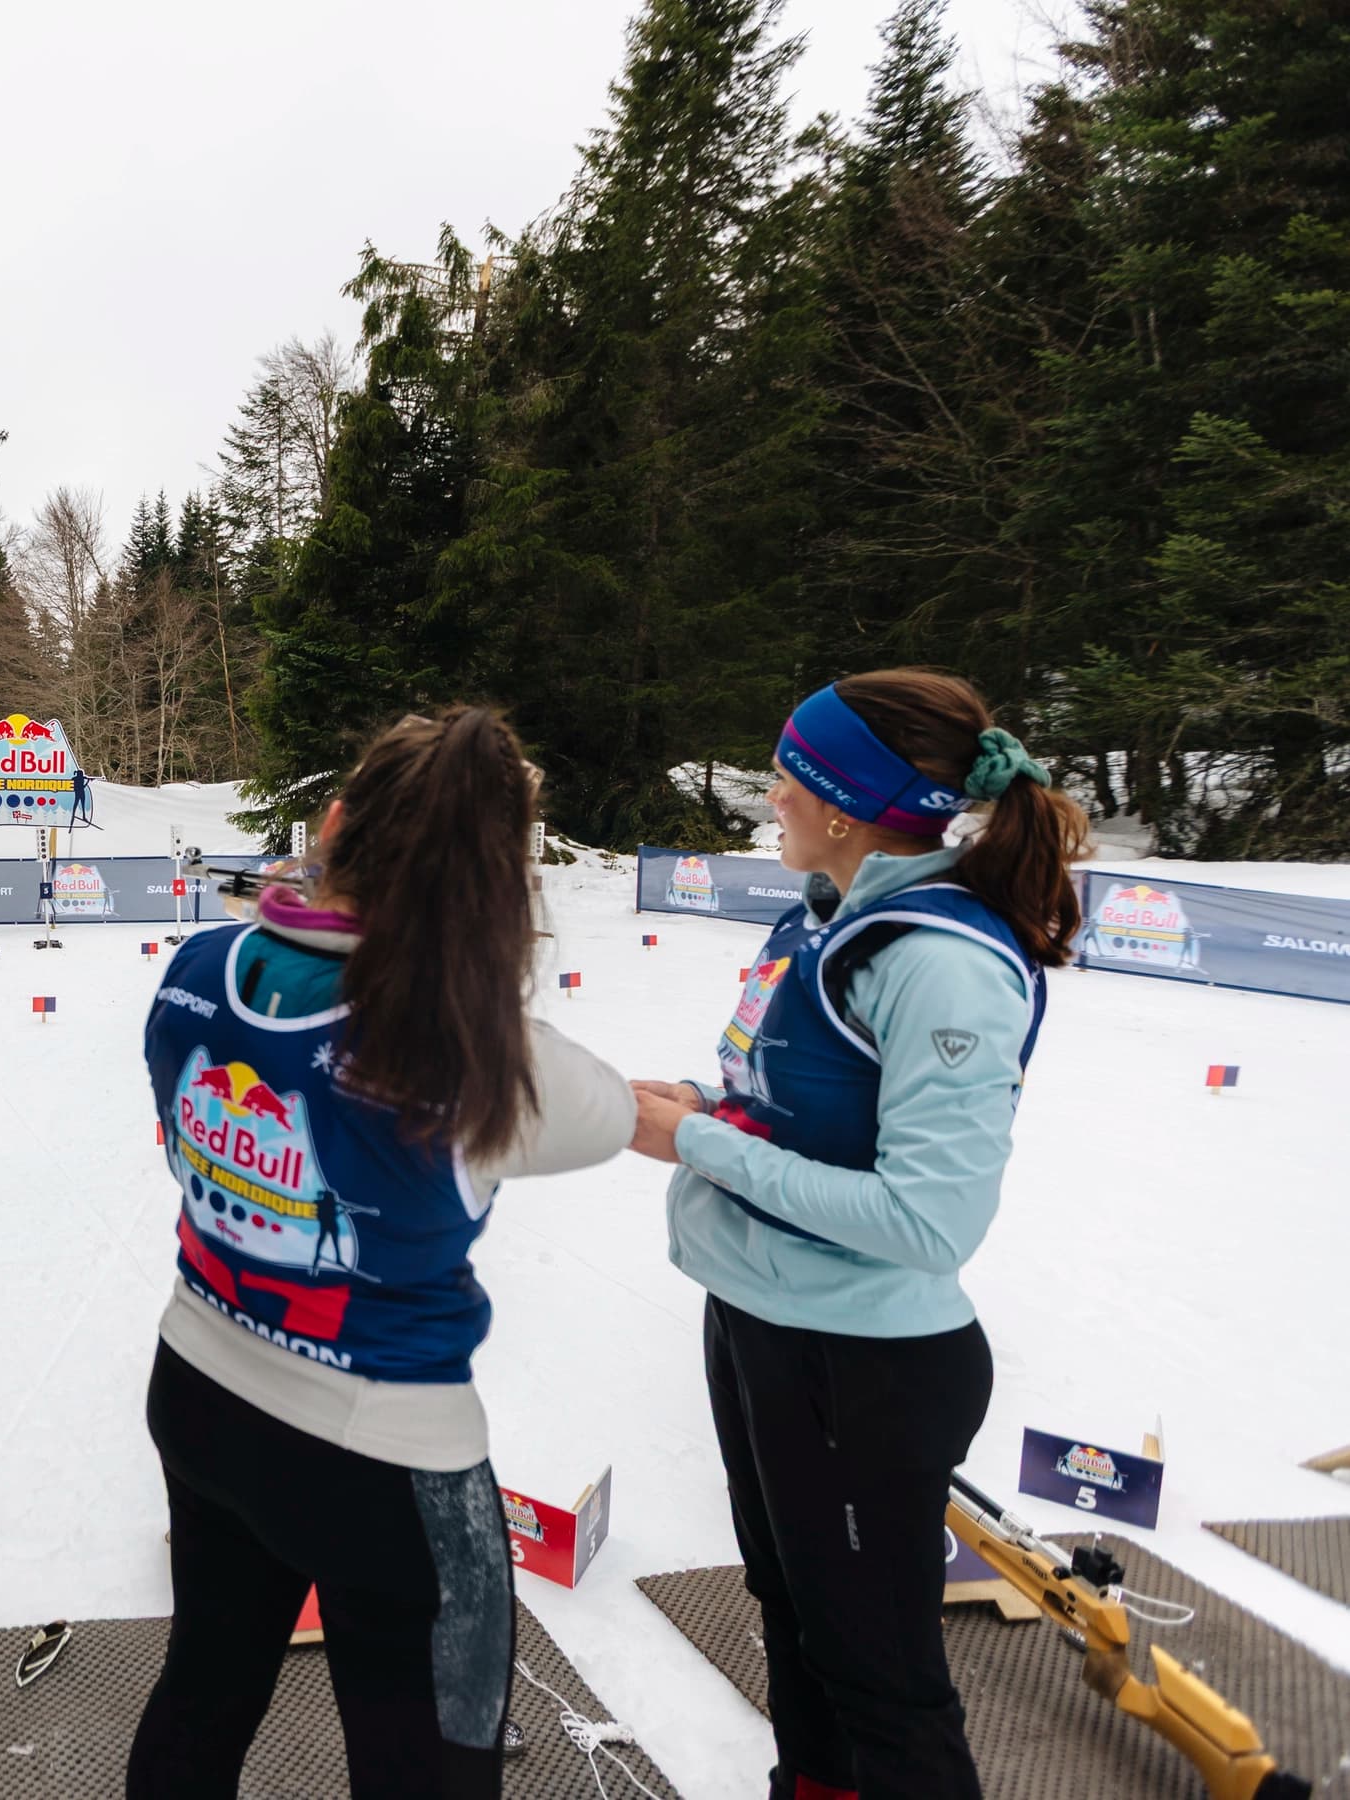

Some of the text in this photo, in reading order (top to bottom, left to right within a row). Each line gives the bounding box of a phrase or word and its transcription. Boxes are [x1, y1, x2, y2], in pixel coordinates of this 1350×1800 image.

[20, 750, 65, 774] Bull
[6, 778, 75, 792] NORDIQUE
[53, 879, 100, 891] Red Bull
[675, 871, 708, 886] Red Bull
[146, 884, 208, 894] SALON
[747, 886, 803, 900] SALOMON
[1103, 906, 1179, 929] Red Bull
[181, 1096, 304, 1190] Red Bull
[210, 1164, 319, 1220] NORDIQUE
[1070, 1453, 1090, 1466] Red
[1090, 1458, 1111, 1471] Bull
[1074, 1485, 1098, 1510] 5
